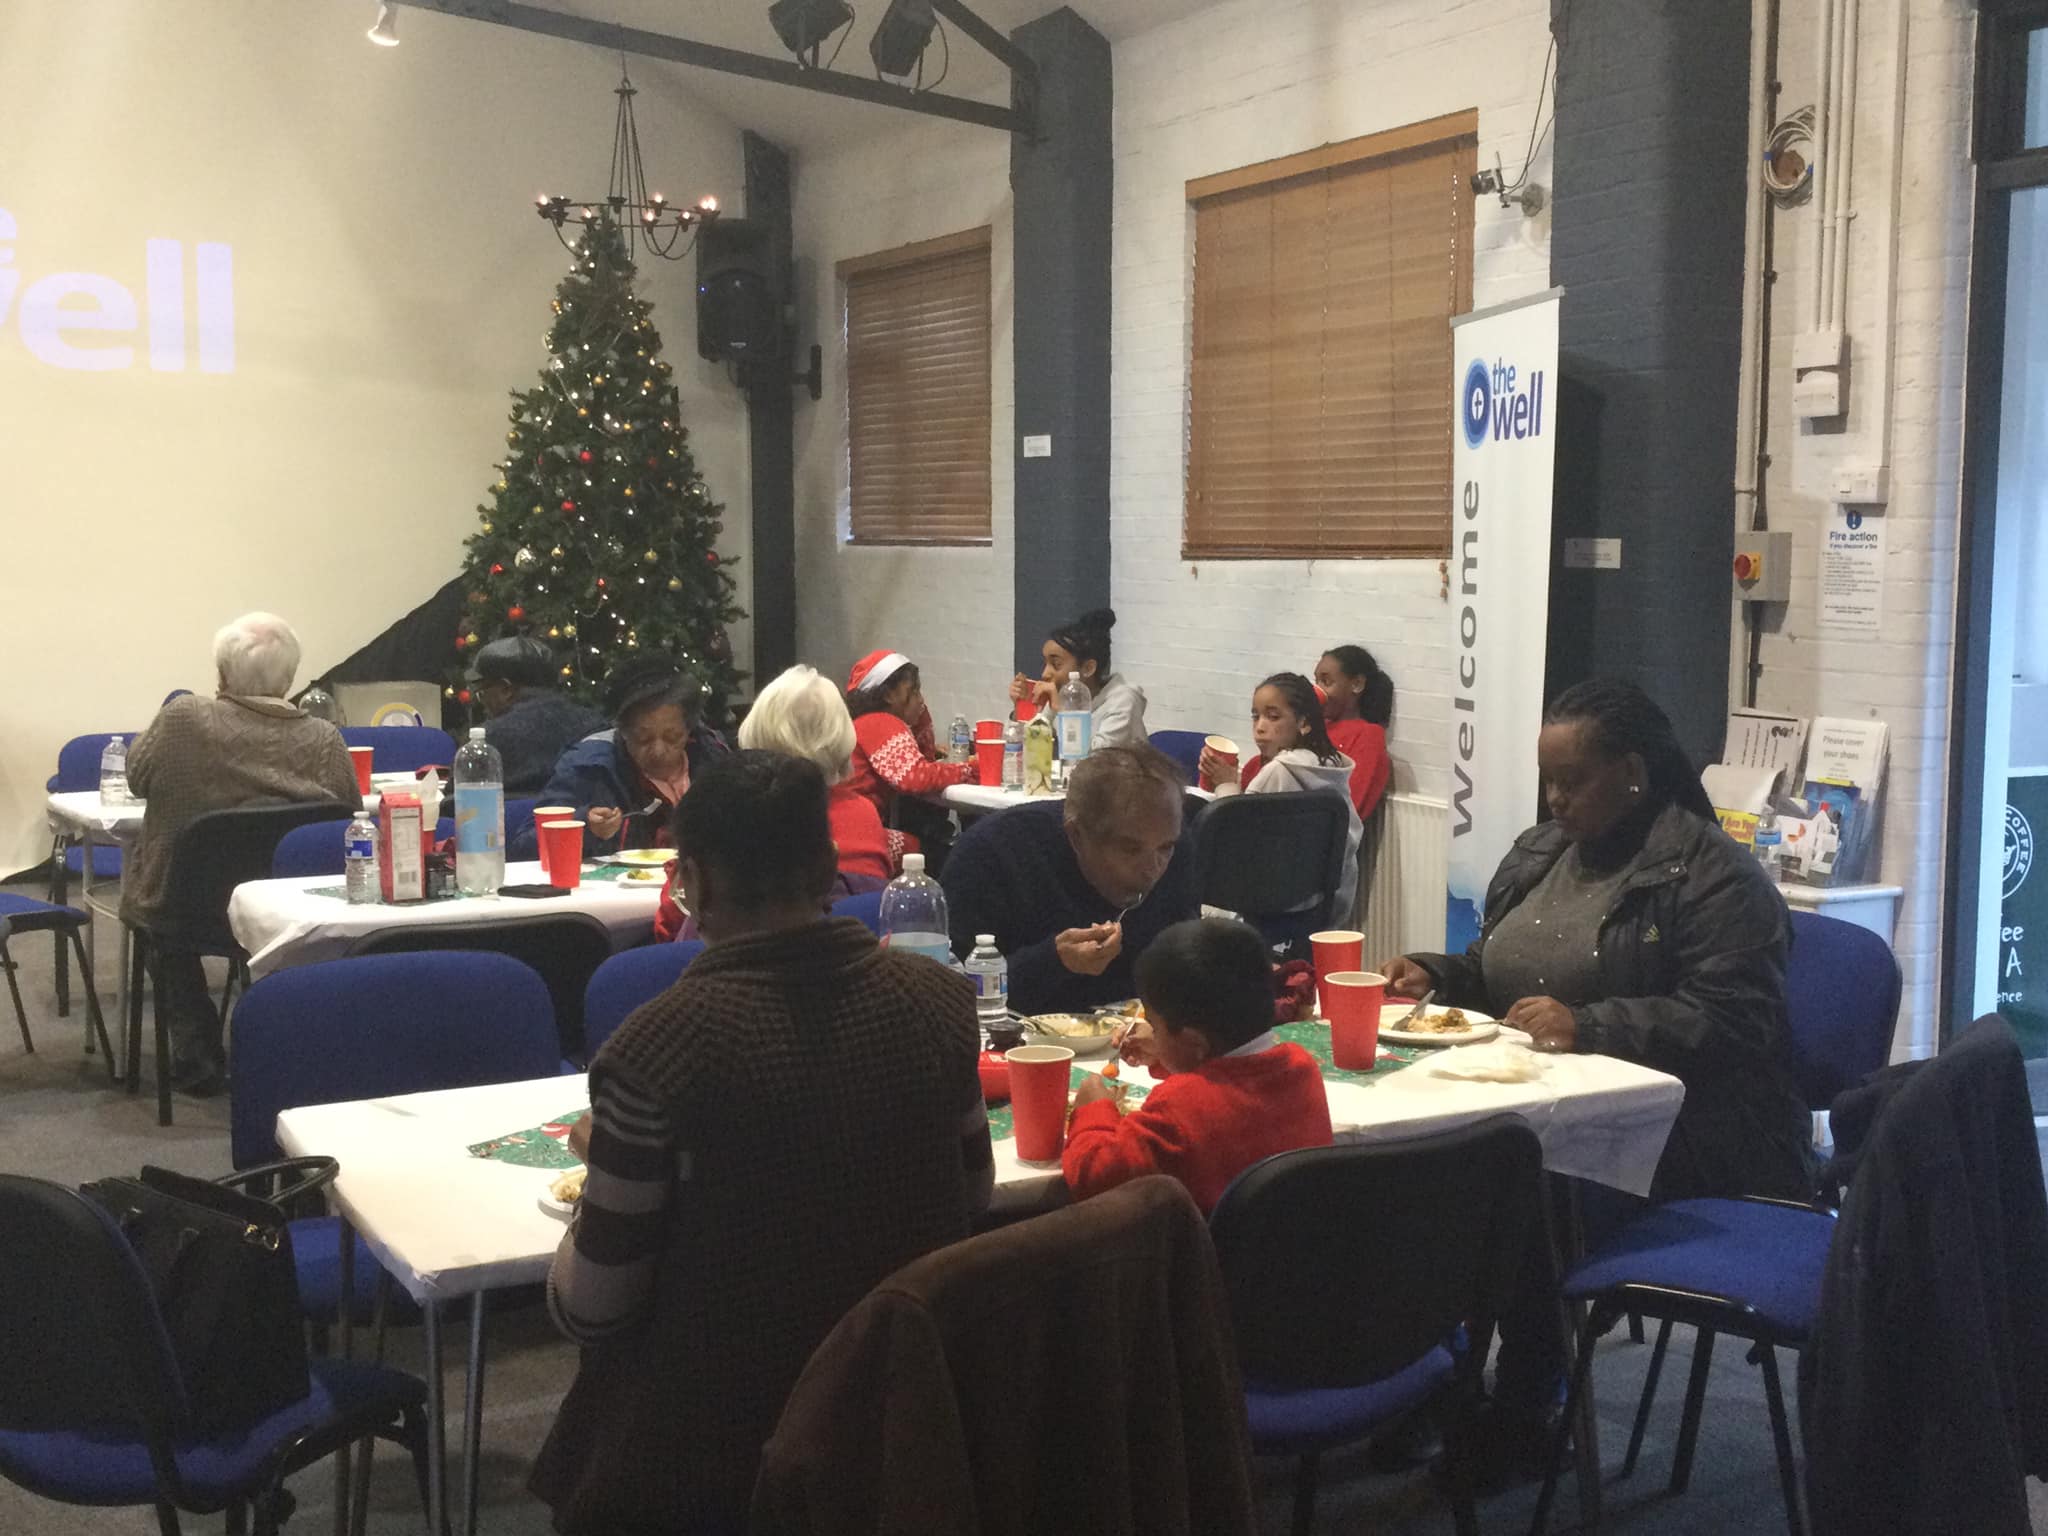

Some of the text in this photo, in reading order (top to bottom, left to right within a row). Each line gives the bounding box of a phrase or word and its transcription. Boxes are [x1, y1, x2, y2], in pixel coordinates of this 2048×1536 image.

[0, 237, 235, 374] ell
[1492, 356, 1516, 395] the
[1492, 370, 1543, 441] well
[1829, 531, 1878, 542] Fire action
[1453, 480, 1480, 839] Welcome
